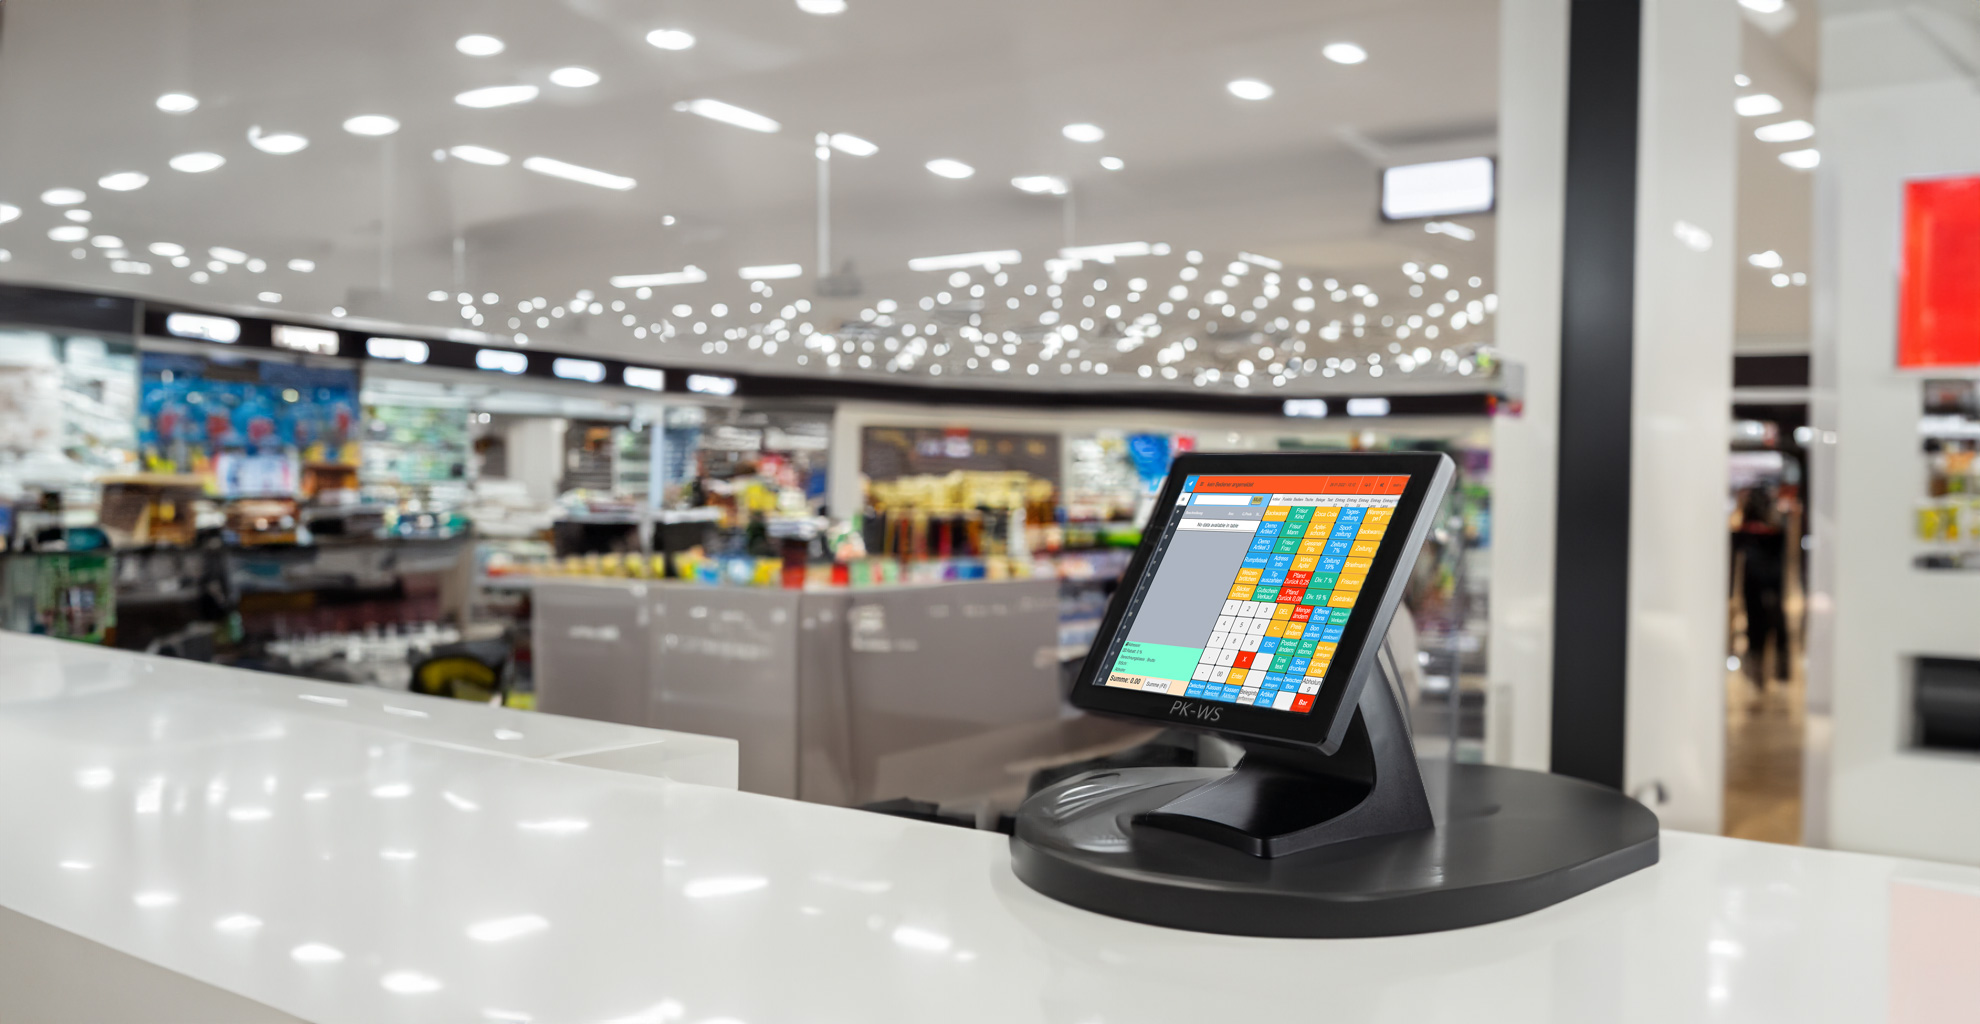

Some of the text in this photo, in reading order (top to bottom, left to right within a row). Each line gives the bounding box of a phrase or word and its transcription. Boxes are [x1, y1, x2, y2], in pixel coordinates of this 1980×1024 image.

[1346, 508, 1360, 516] Tages-
[1324, 557, 1341, 565] Zeitung
[1295, 606, 1311, 614] Menge
[1110, 674, 1141, 685] Summe: 0.00
[1298, 698, 1308, 706] Bar
[1169, 700, 1224, 721] PK-WS
